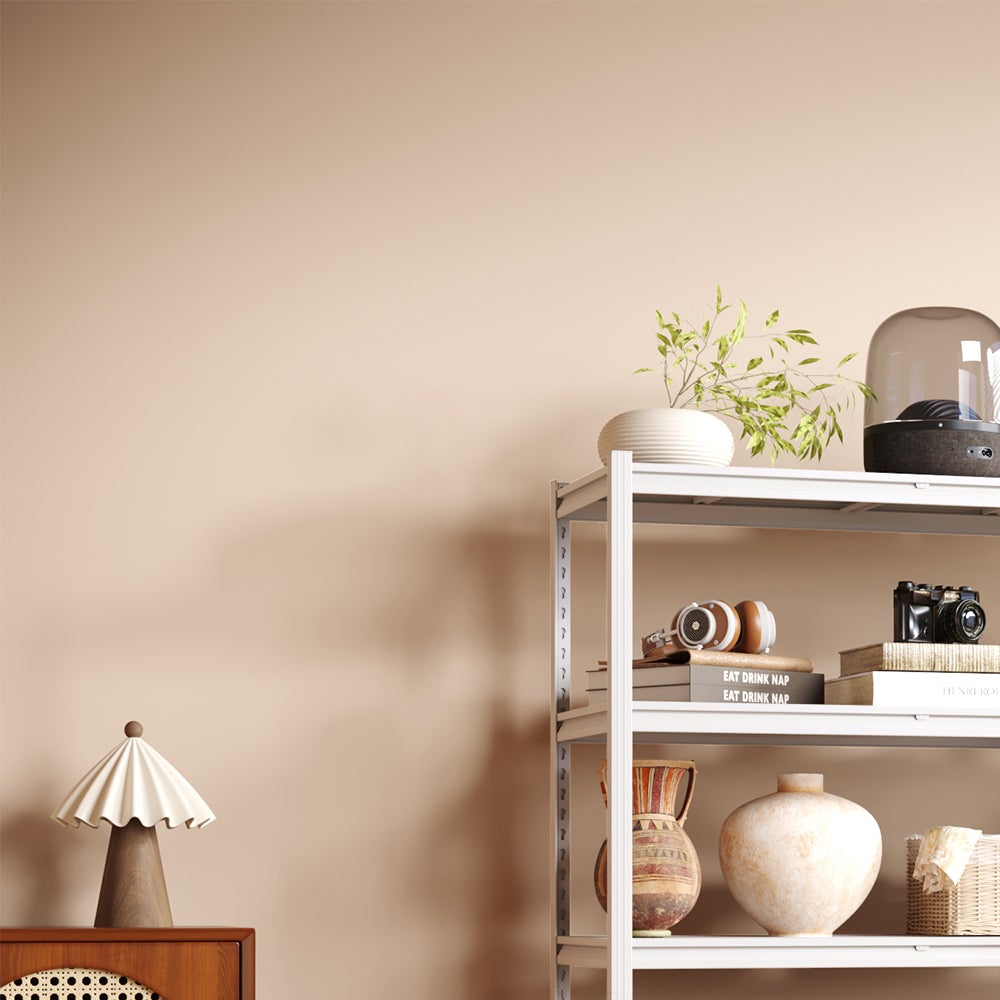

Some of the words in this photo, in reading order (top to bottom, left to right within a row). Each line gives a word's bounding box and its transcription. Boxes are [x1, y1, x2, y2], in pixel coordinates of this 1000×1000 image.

[723, 670, 740, 682] EAT
[742, 672, 769, 685] DRINK
[771, 674, 790, 686] NAP
[723, 690, 740, 701] EAT
[742, 690, 769, 704] DRINK
[771, 693, 790, 704] NAP
